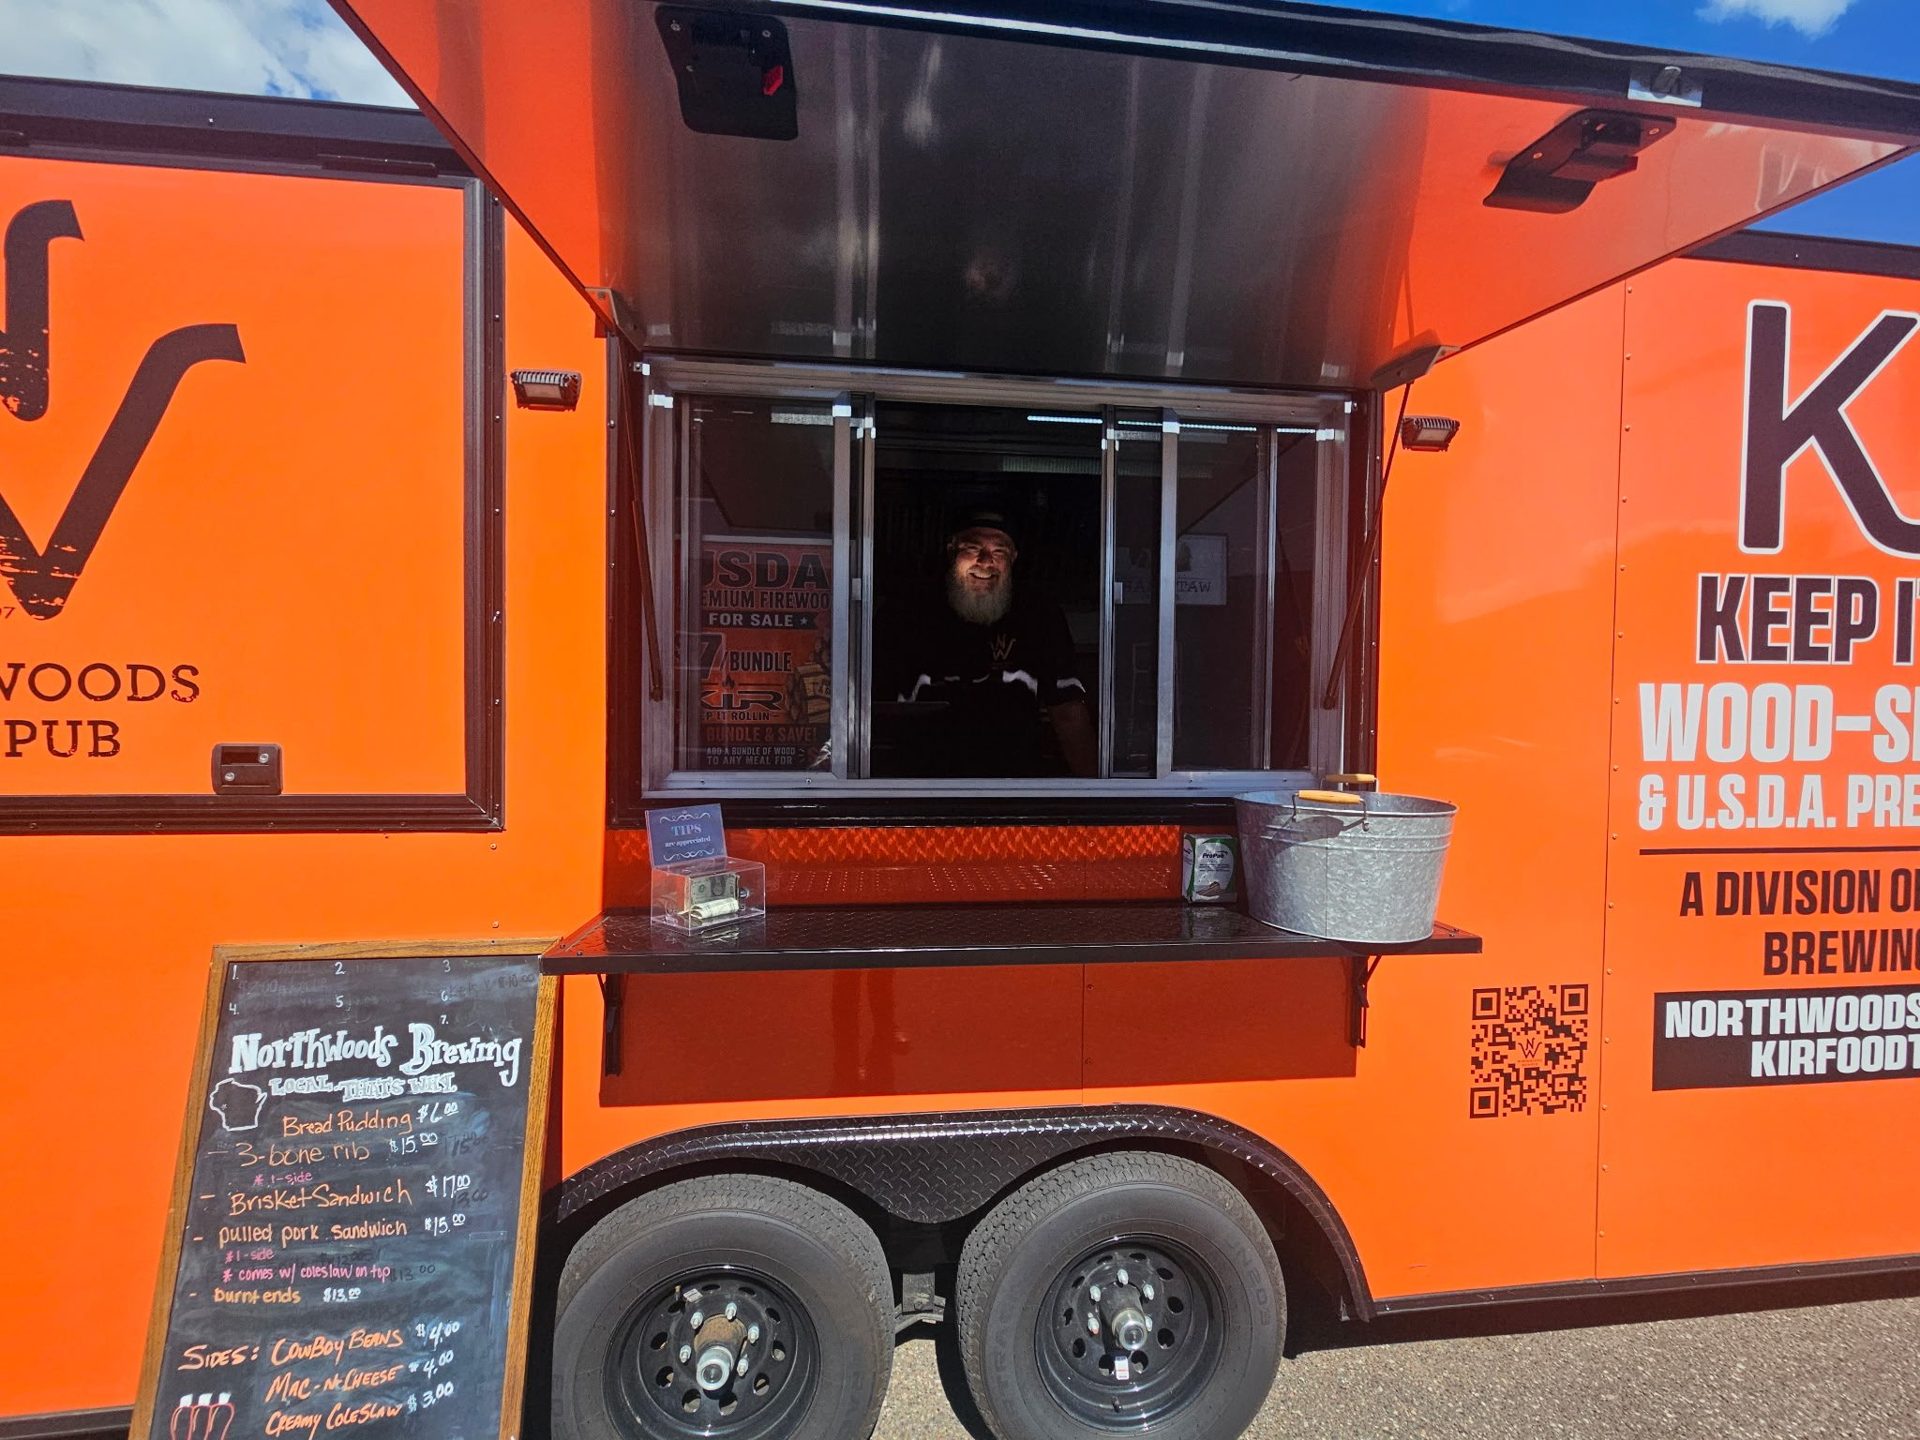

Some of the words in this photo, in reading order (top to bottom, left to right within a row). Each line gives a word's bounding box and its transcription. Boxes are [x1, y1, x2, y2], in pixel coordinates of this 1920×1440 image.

[709, 613, 743, 626] FOR
[750, 614, 793, 627] SALE
[1696, 572, 1881, 665] KEEP
[1893, 577, 1920, 666] I
[707, 726, 760, 742] BUNDLE
[766, 728, 776, 742] &
[778, 728, 817, 743] SAVE!
[1639, 682, 1920, 763] WOOD-S
[4, 719, 121, 758] PUB
[707, 747, 721, 756] ADD
[724, 747, 729, 756] A
[732, 747, 760, 756] BUNDLE
[763, 747, 772, 756] OF
[774, 747, 795, 756] WOOD
[707, 756, 719, 765] TO
[722, 755, 744, 765] ANY
[746, 755, 772, 765] MEAL
[774, 755, 793, 765] FOR
[1639, 774, 1667, 831] &
[1677, 774, 1836, 831] U.S.D.A.
[671, 824, 702, 837] TIPS
[1680, 872, 1704, 917] A
[1716, 869, 1881, 916] DIVISION
[1764, 928, 1920, 976] BREWIN
[399, 1022, 523, 1087] Brewing
[282, 1113, 333, 1137] Bread
[337, 1109, 413, 1135] Pudding
[236, 1142, 325, 1167] 3-bone
[333, 1141, 370, 1160] rib
[311, 1179, 413, 1207] Sandwich
[219, 1223, 273, 1249] pulled
[281, 1224, 319, 1248] pork
[330, 1218, 408, 1240] sandwich
[239, 1269, 274, 1281] comes
[279, 1263, 296, 1284] w/
[300, 1263, 353, 1279] coleslaw
[355, 1265, 368, 1278] on
[370, 1263, 391, 1284] top
[262, 1286, 302, 1304] ends
[348, 1328, 404, 1350] BEANS
